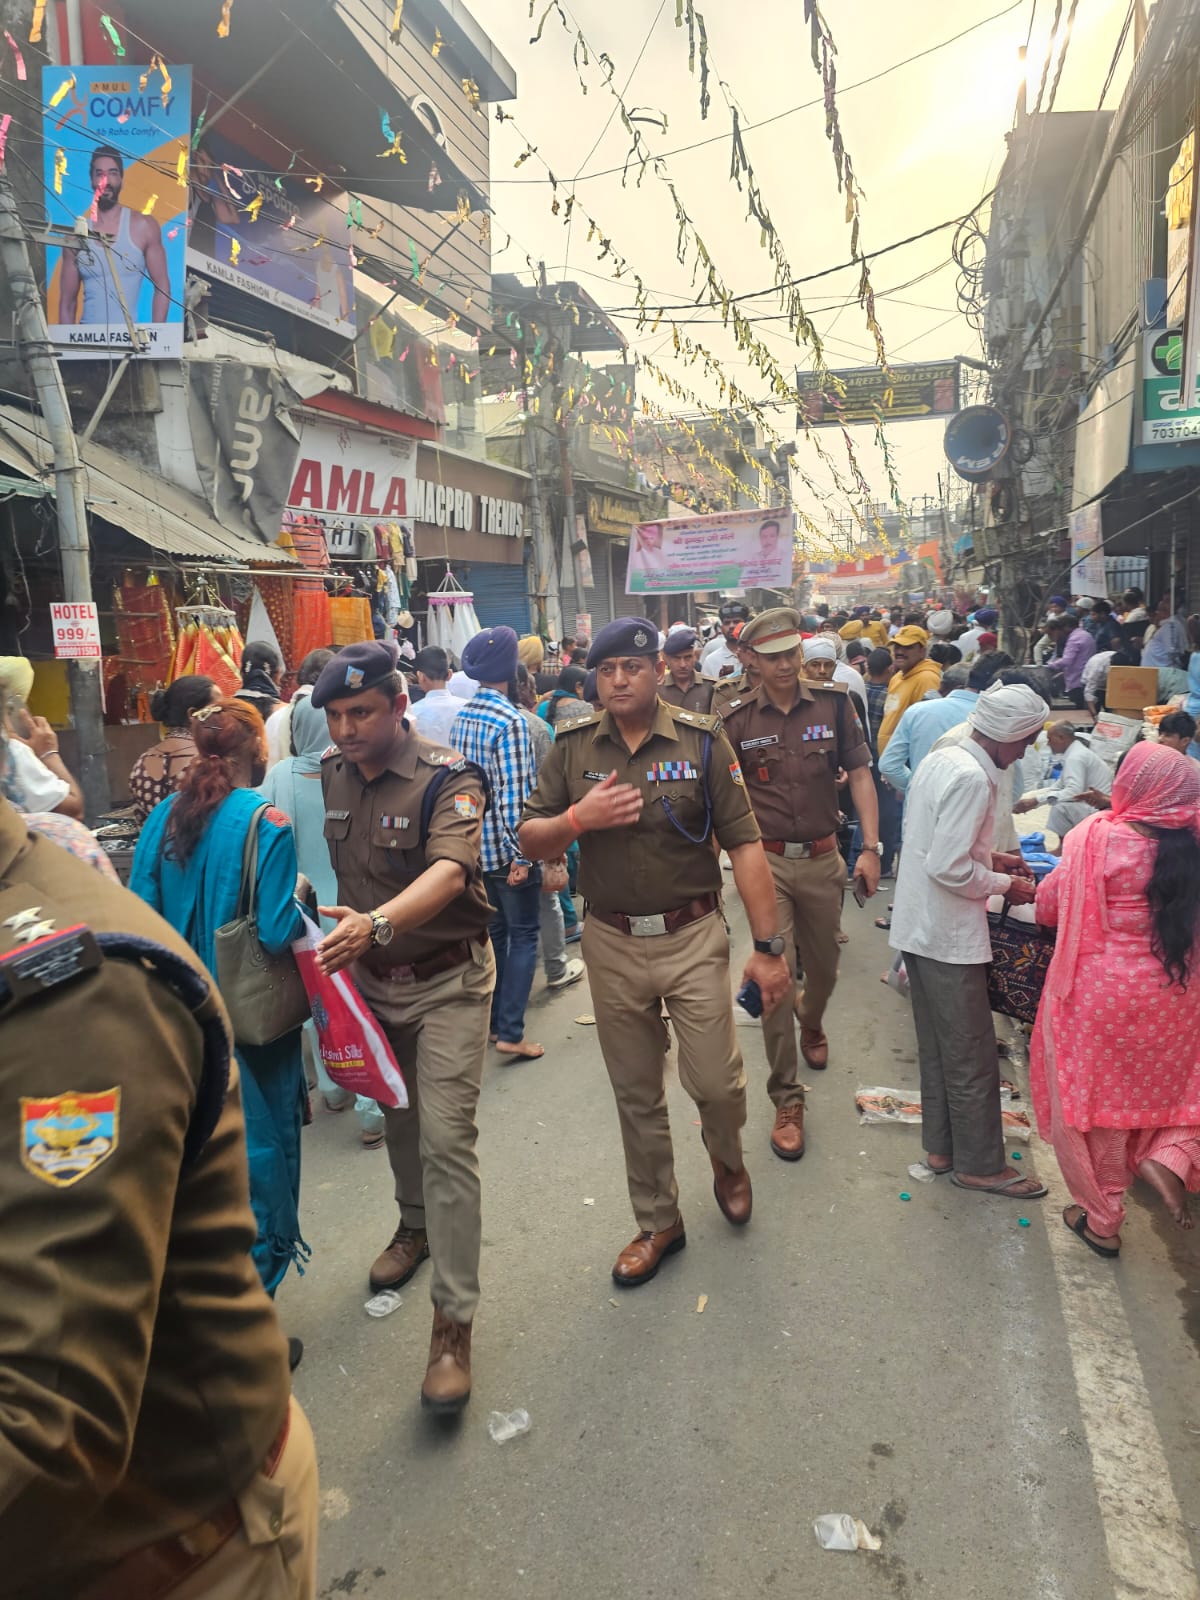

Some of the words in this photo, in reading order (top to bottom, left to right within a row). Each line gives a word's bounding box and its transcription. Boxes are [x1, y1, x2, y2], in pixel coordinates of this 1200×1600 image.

[90, 96, 175, 118] COMFY
[206, 261, 235, 282] KAMLA
[237, 273, 270, 300] FASHION
[69, 332, 106, 343] KAMLA
[109, 331, 158, 342] FASN
[886, 368, 953, 384] HOLESALE
[1152, 426, 1200, 439] 703704
[415, 478, 473, 532] MACPRO
[480, 495, 523, 538] TRENDS
[53, 604, 95, 620] HOTEL
[56, 627, 97, 641] 999/-
